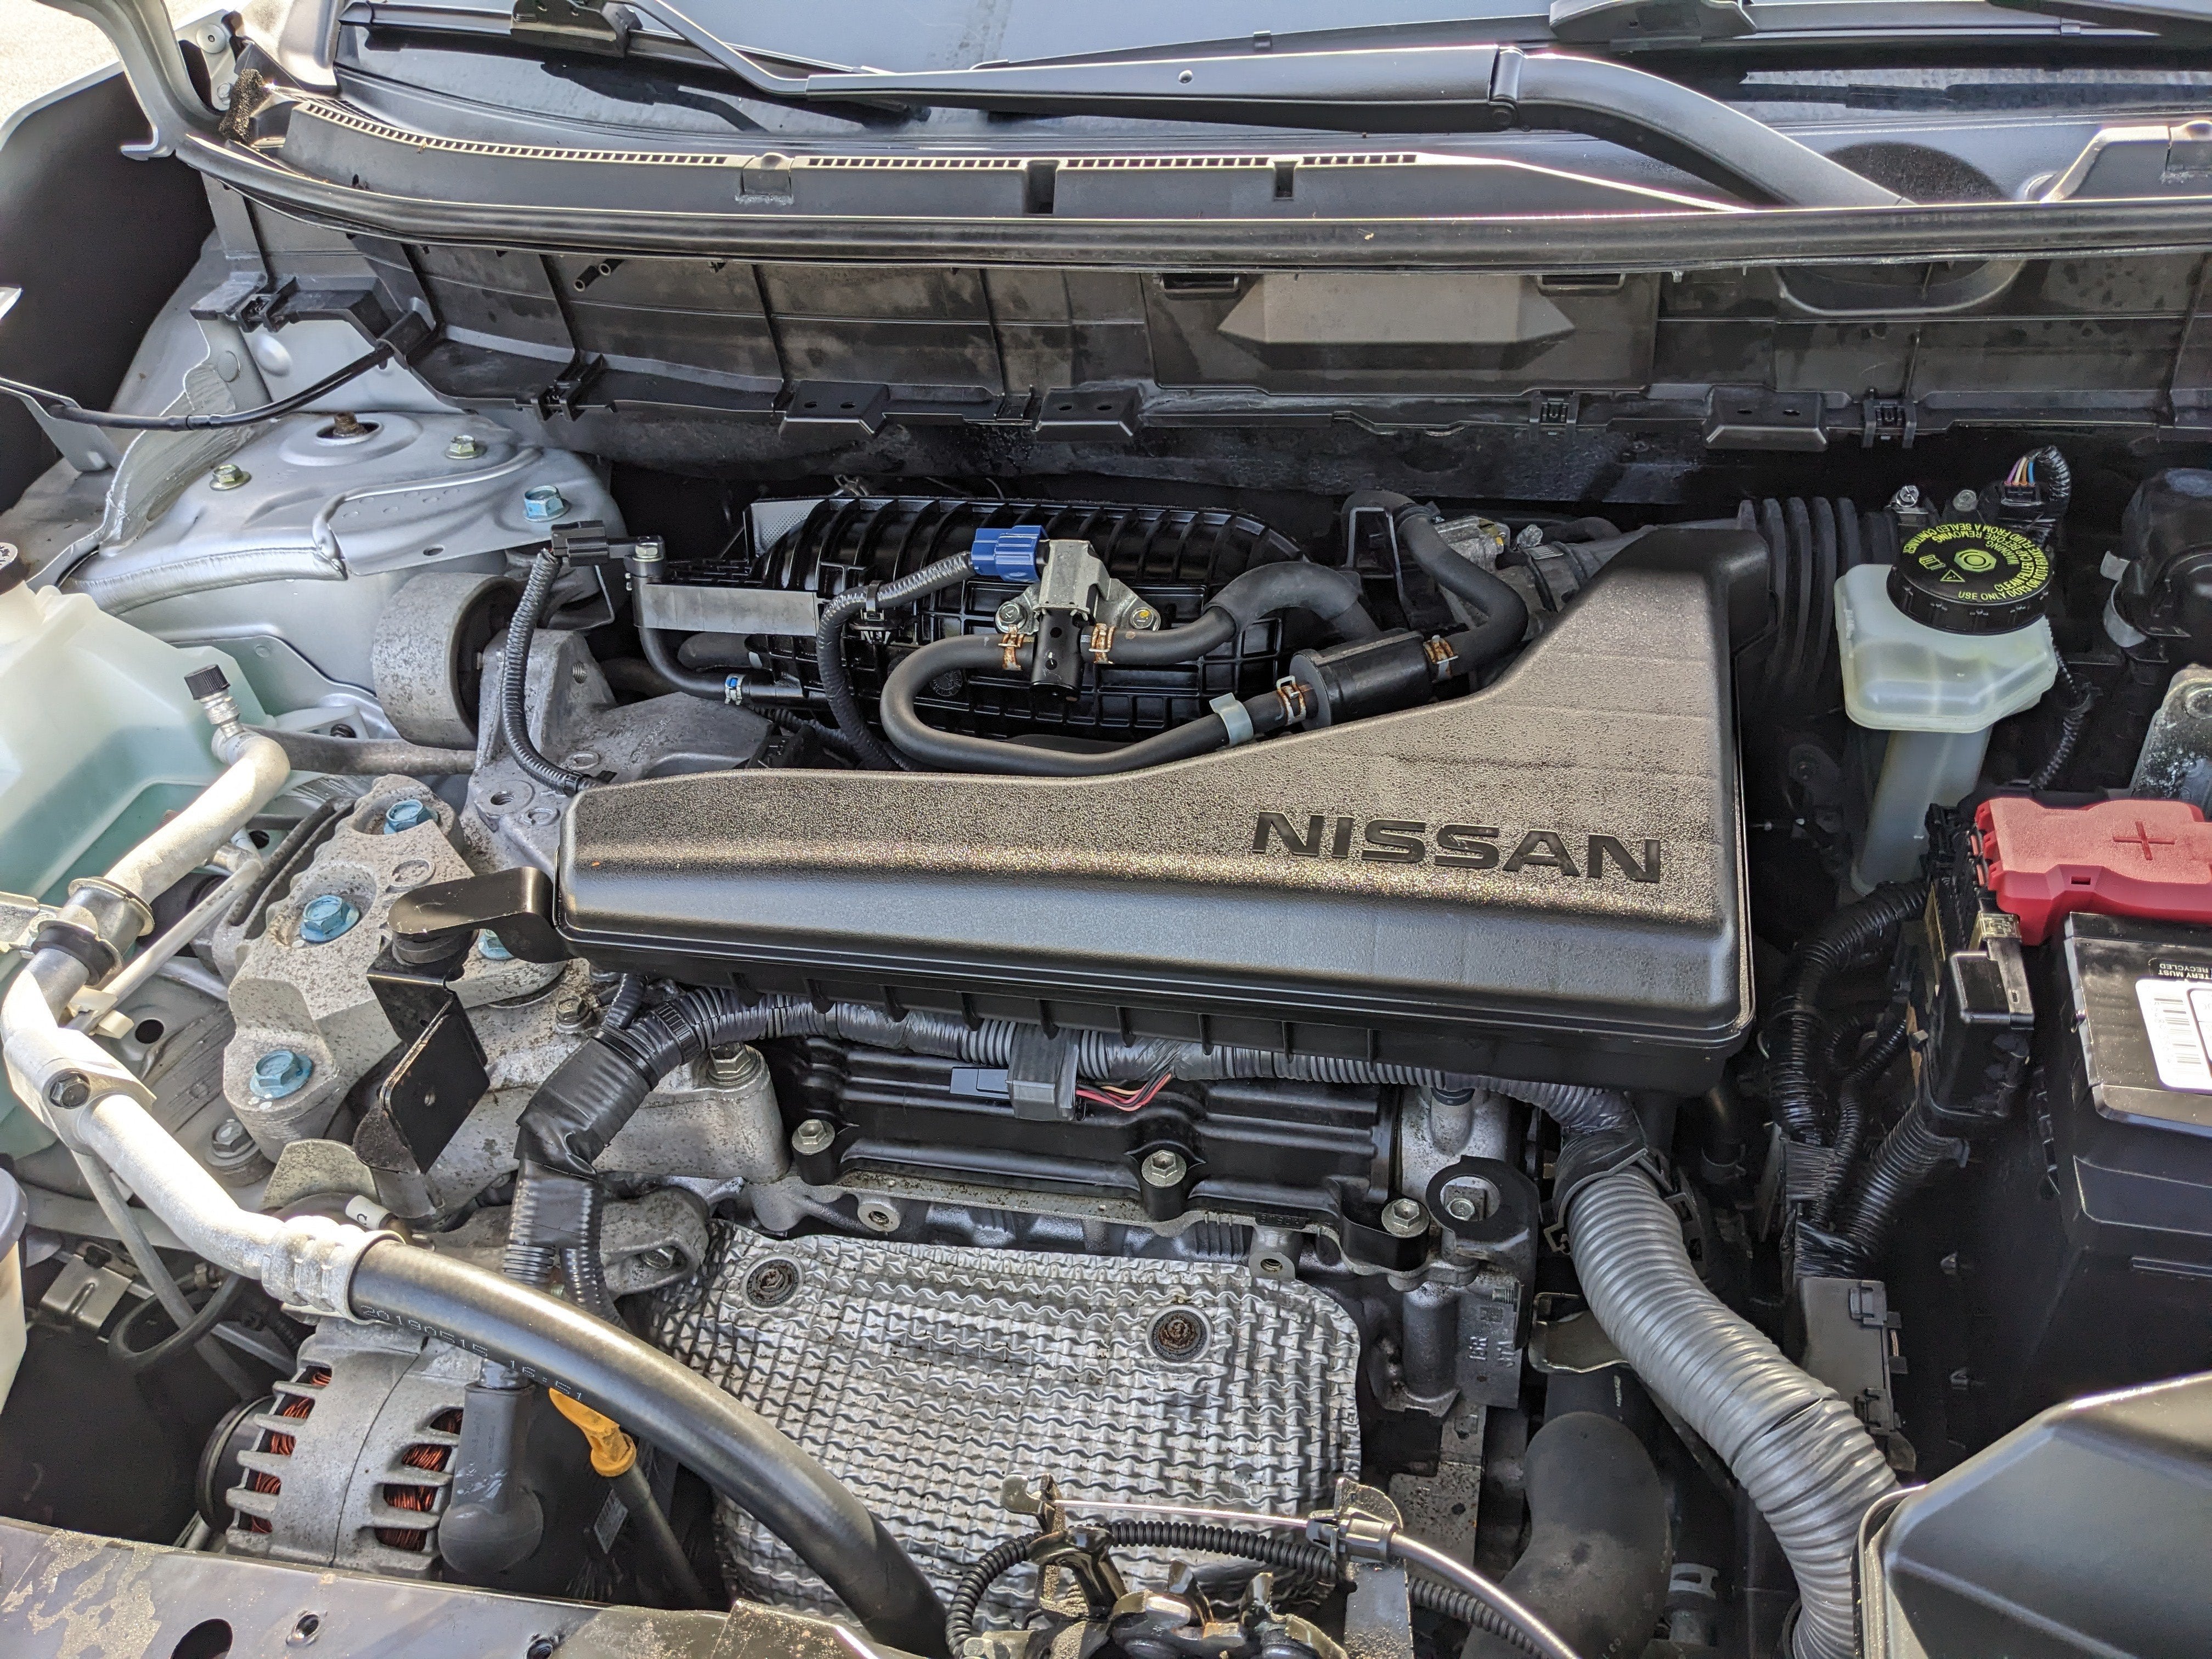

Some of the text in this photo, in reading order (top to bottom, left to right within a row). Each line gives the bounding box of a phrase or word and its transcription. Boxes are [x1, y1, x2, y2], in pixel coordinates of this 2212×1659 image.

[1936, 523, 1971, 533] SEALED
[1983, 524, 2012, 538] FROM
[2010, 533, 2035, 549] FLUID
[1985, 540, 2020, 565] WARNING
[2028, 547, 2049, 566] BRAKE
[1932, 530, 2035, 592] CLEAN FILLER CAP BEFORE REMOVING
[2033, 566, 2049, 580] DOT4
[2026, 578, 2042, 588] OR
[1958, 591, 1978, 600] USE
[1980, 591, 2007, 601] ONLY
[2006, 585, 2032, 597] DOT3
[1251, 810, 1662, 883] NISSAN
[2158, 969, 2184, 978] MUST
[2159, 963, 2209, 974] RECYCLED
